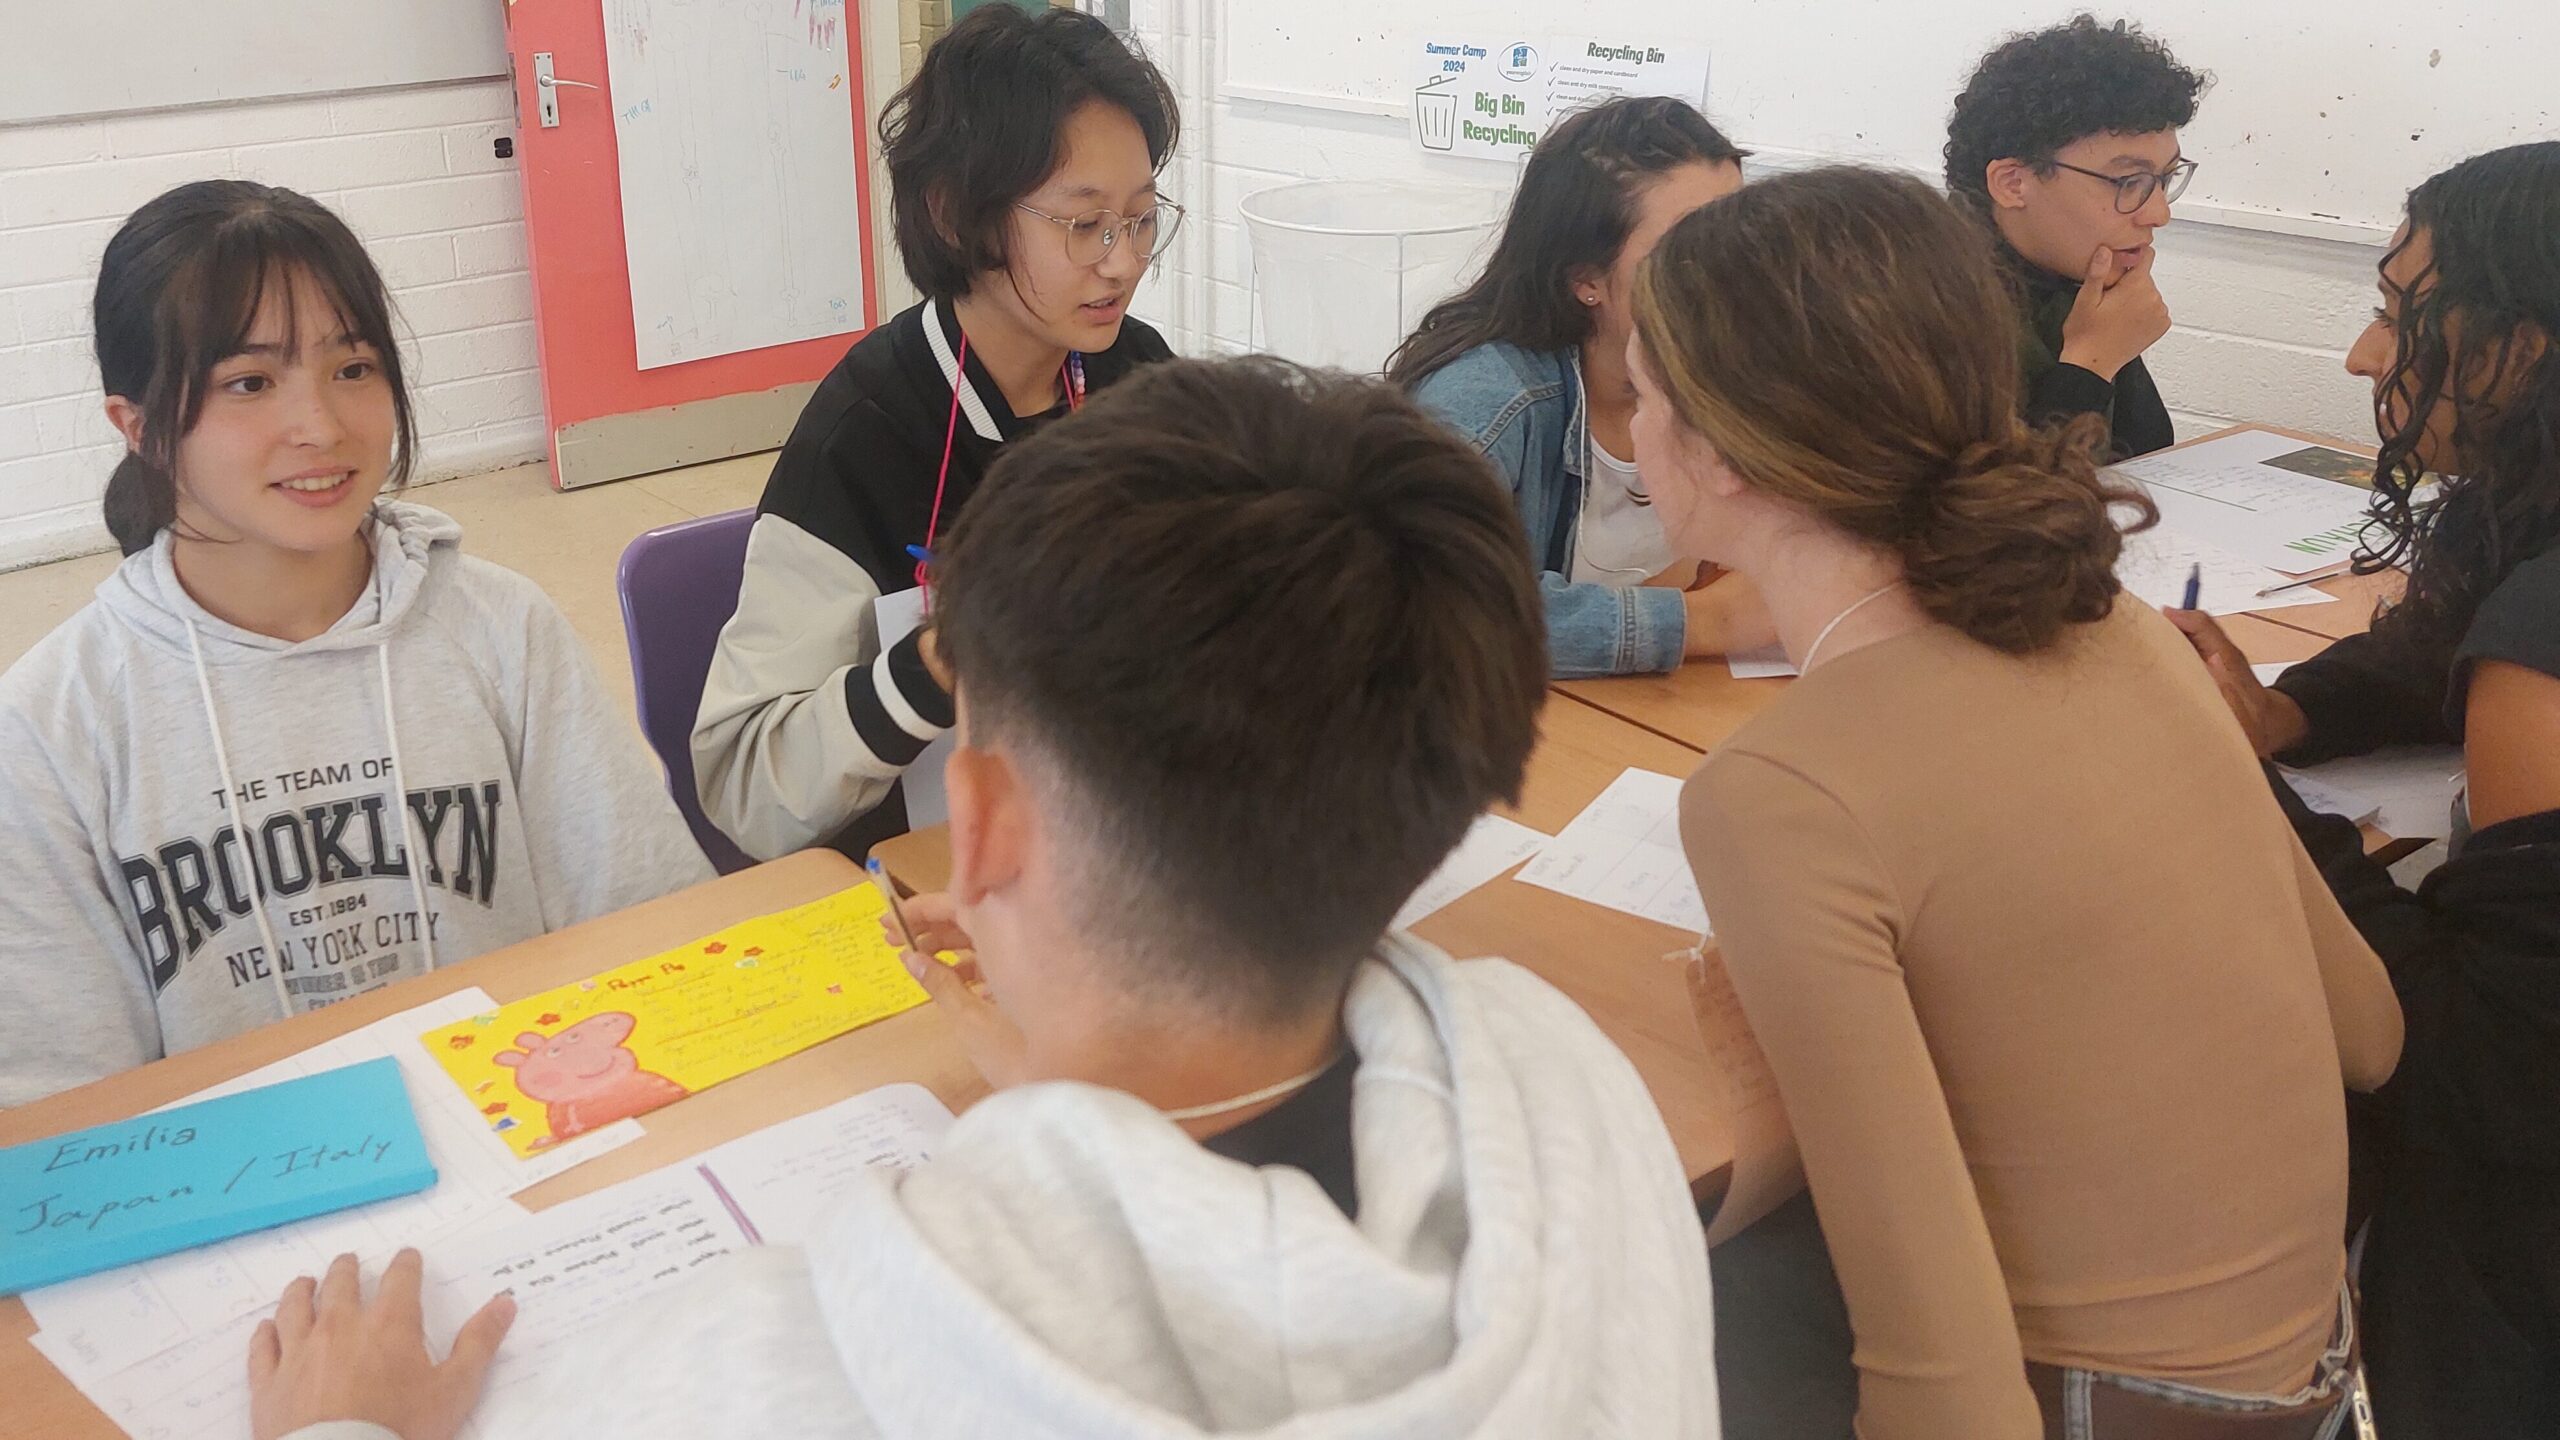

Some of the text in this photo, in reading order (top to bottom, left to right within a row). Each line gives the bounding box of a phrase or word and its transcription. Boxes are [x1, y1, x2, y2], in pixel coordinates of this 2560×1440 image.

[1426, 42, 1487, 60] Summer Camp
[1443, 60, 1465, 72] 2024
[1587, 42, 1665, 65] Recycling Bin
[1475, 91, 1525, 118] Big Bin
[1463, 119, 1537, 150] Recycling
[212, 757, 394, 809] THE TEAM OF
[121, 779, 503, 999] BROOKLYN
[302, 922, 368, 969] YORK
[375, 911, 440, 949] CITY
[43, 1125, 197, 1173] Emilia
[15, 1183, 194, 1235] Japan
[273, 1134, 393, 1179] Italy
